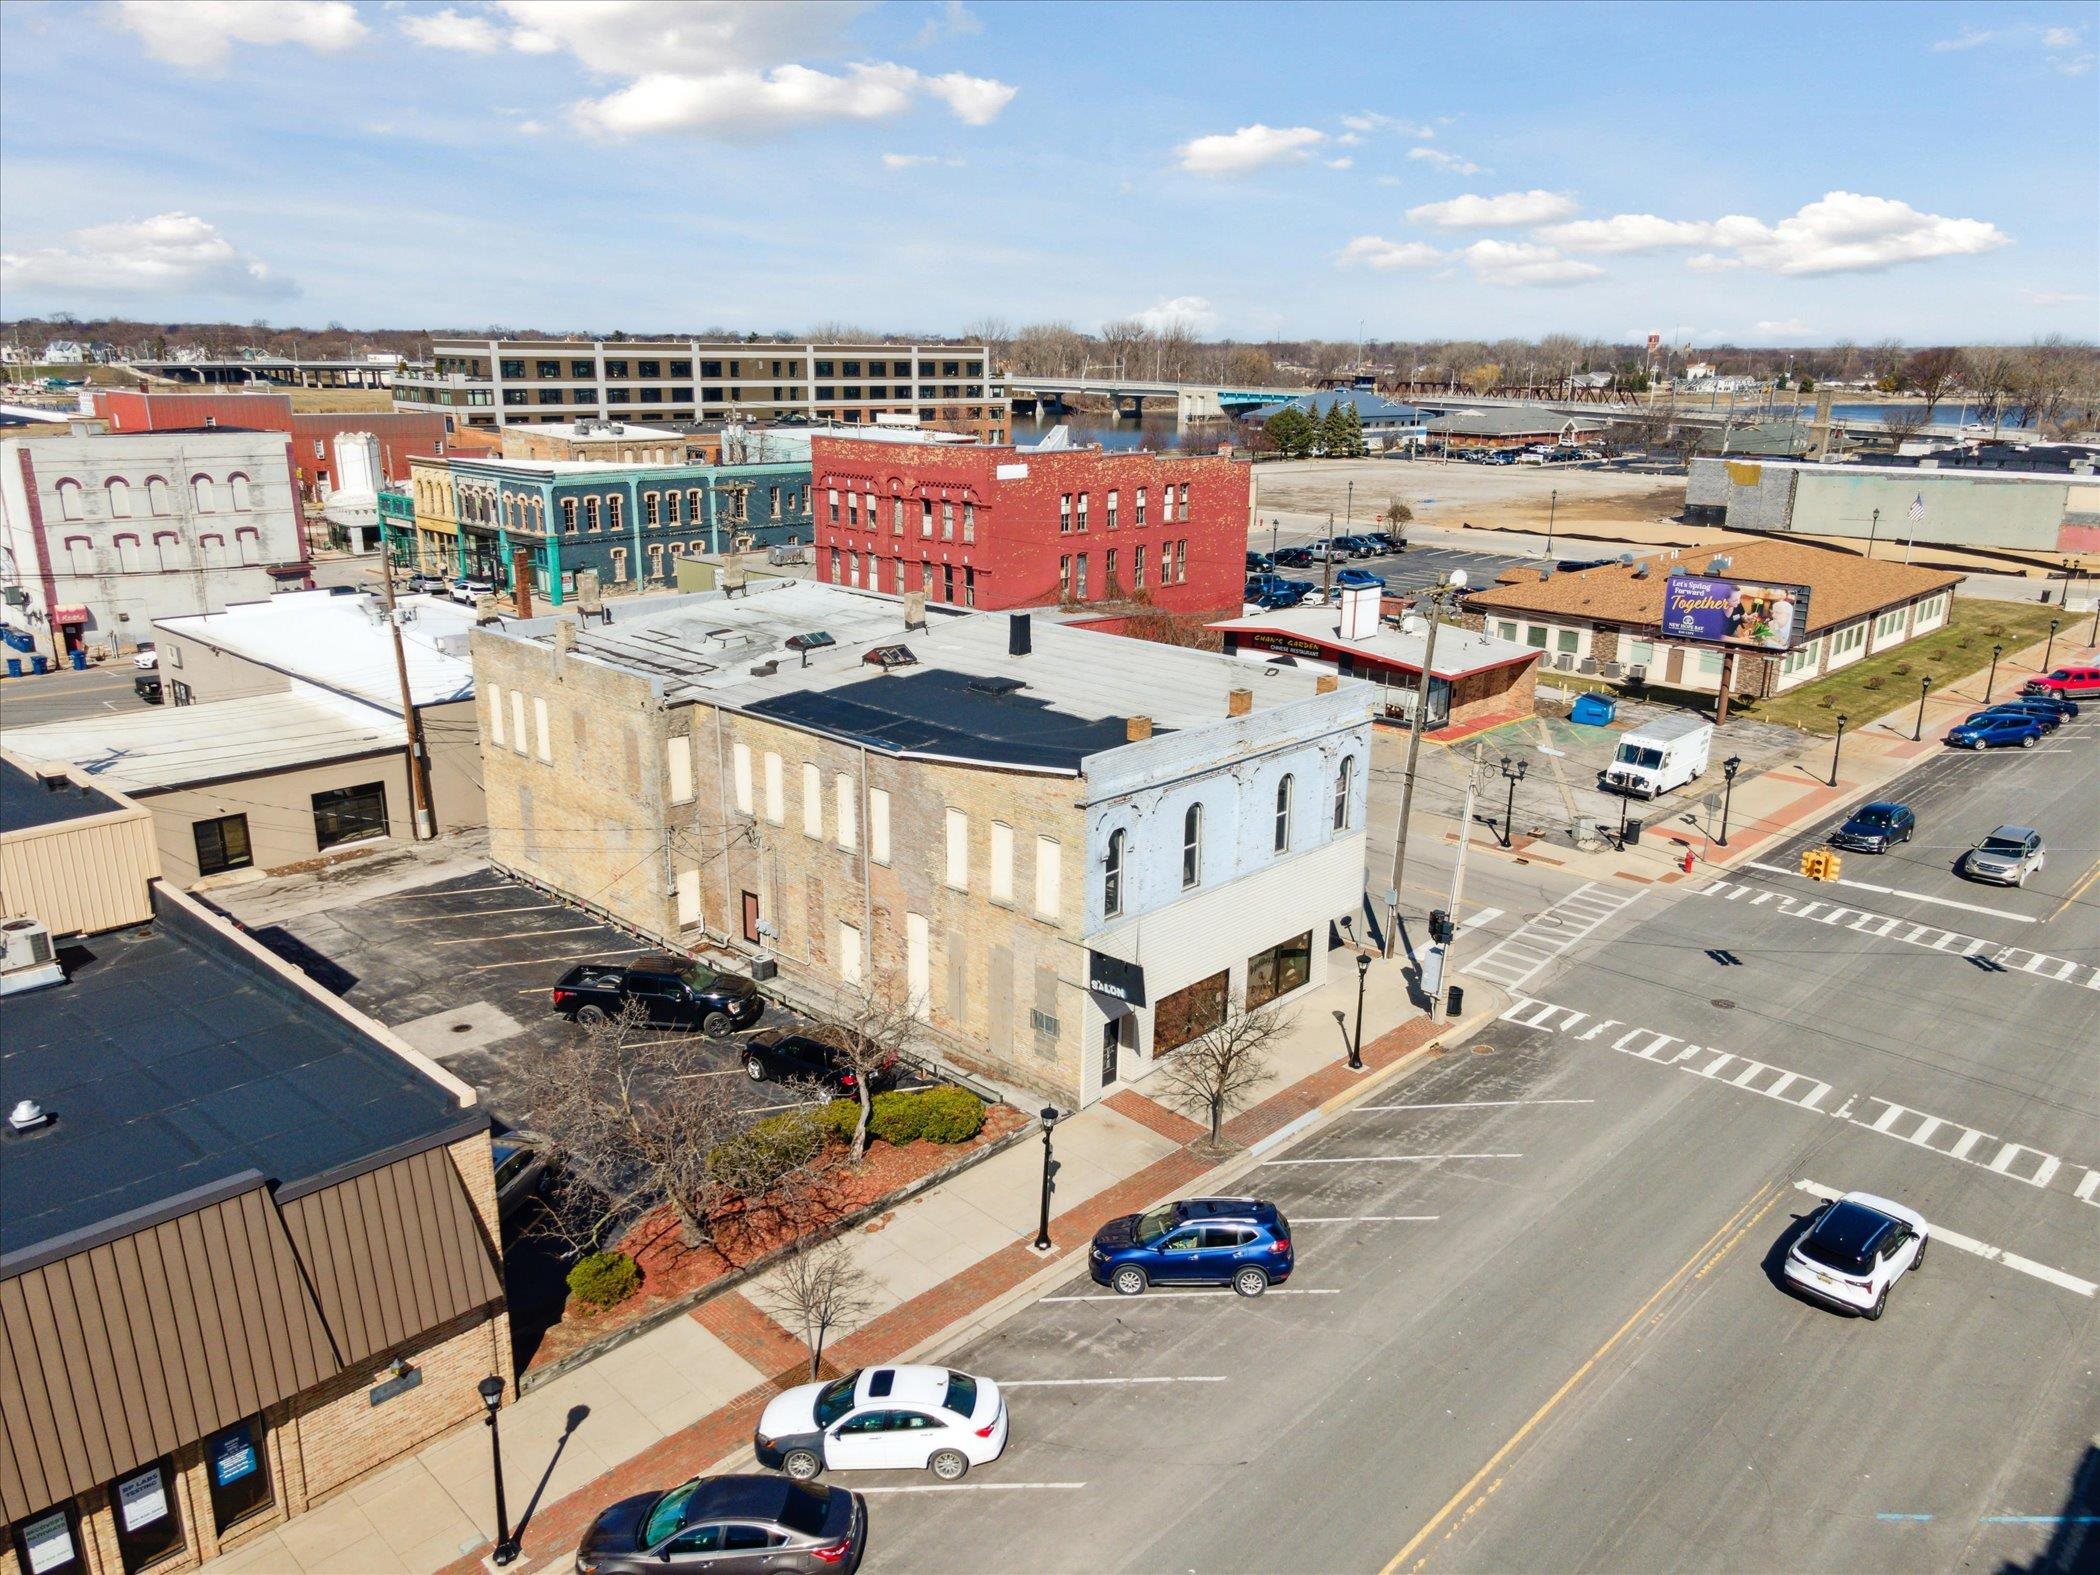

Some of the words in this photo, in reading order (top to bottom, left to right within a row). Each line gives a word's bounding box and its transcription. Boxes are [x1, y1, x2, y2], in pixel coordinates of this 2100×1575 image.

[1672, 580, 1688, 588] Let's
[1688, 581, 1712, 592] Spring
[1674, 587, 1705, 596] Forward
[1671, 595, 1730, 614] Together
[1270, 644, 1289, 652] CHINESE
[1290, 648, 1319, 656] RESTAURANT
[1287, 640, 1319, 649] GARDEN
[1091, 980, 1127, 999] SALON
